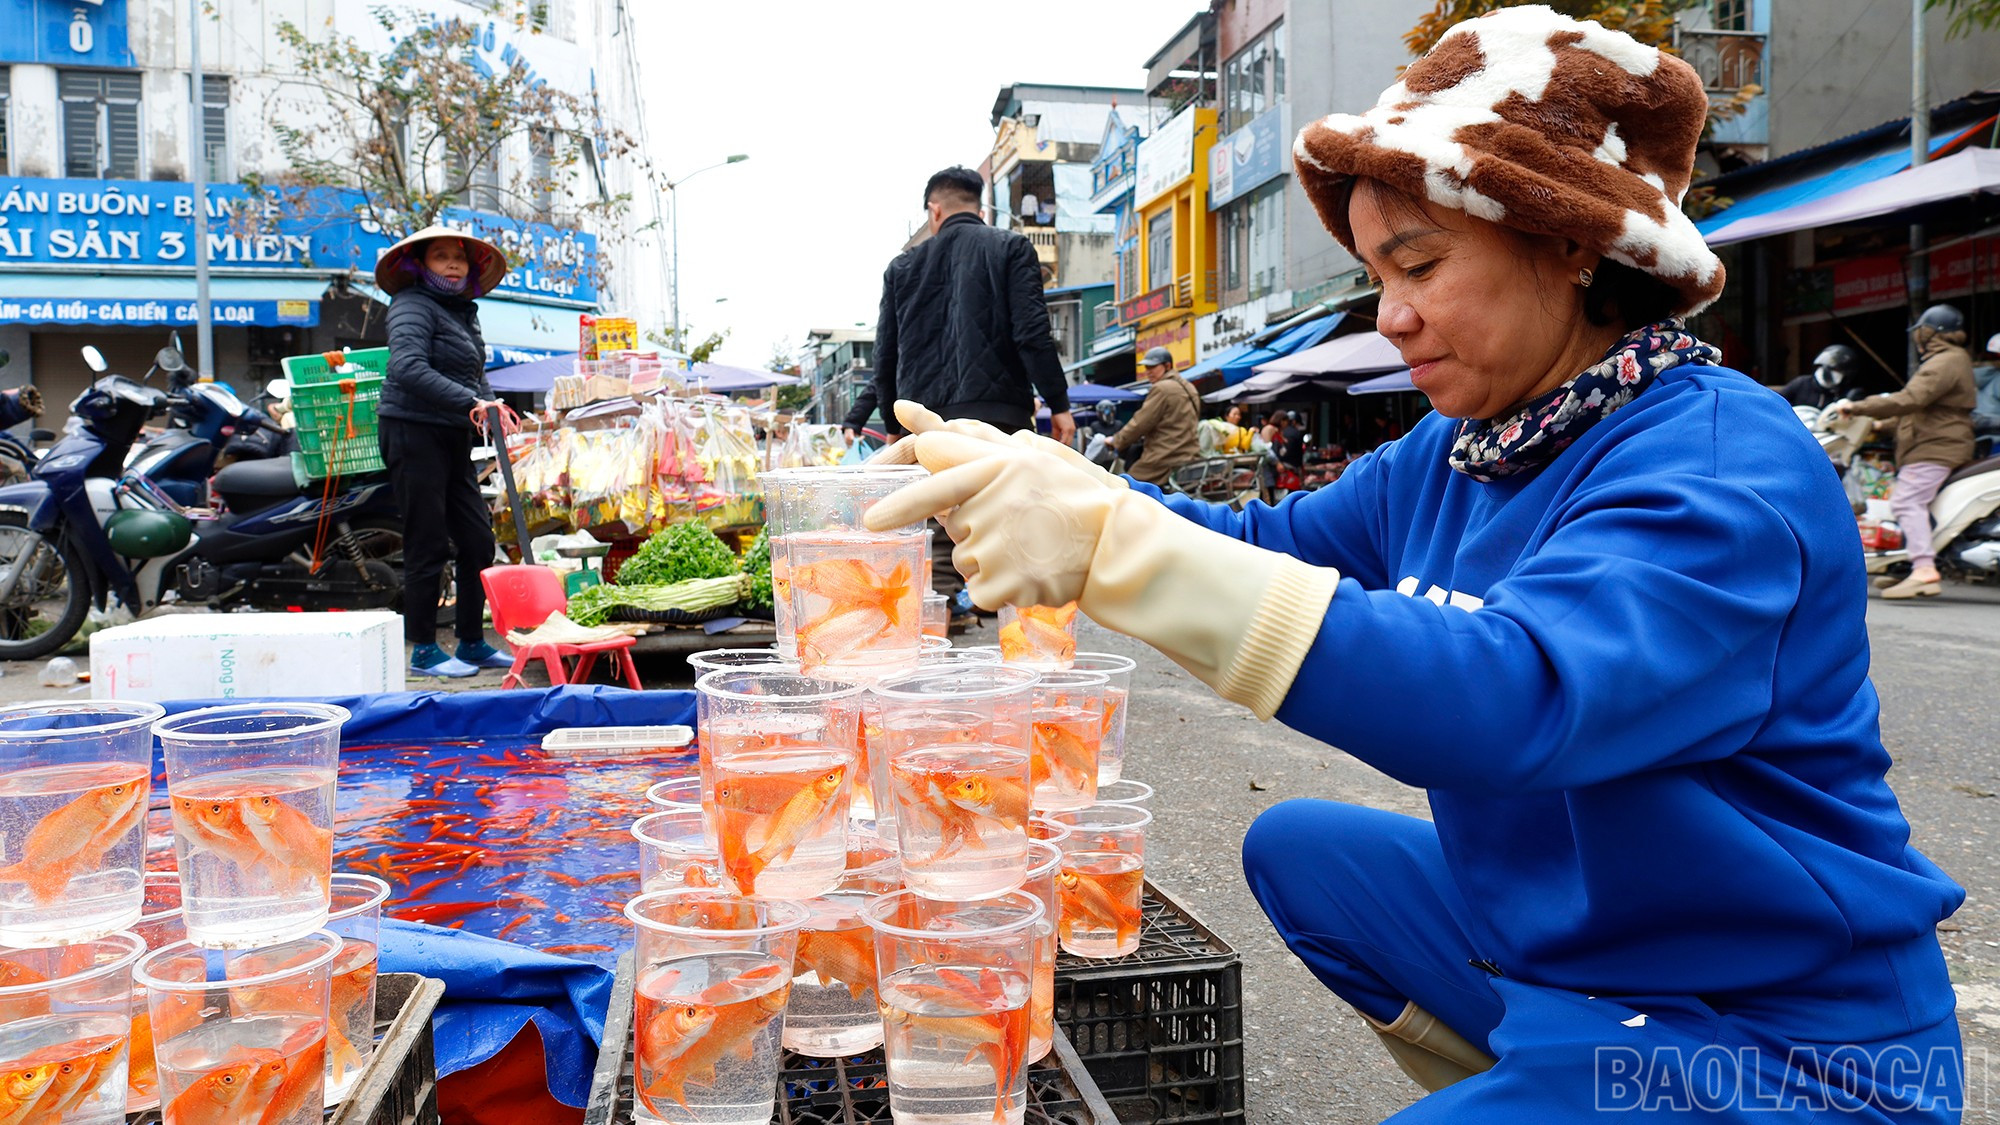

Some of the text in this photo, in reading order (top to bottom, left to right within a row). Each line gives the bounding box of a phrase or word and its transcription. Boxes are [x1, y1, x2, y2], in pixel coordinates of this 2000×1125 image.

[58, 187, 149, 215] BUÔN
[48, 219, 141, 260] SẢN
[158, 231, 187, 260] 3
[214, 306, 255, 323] LOẠI
[218, 649, 236, 684] Nông
